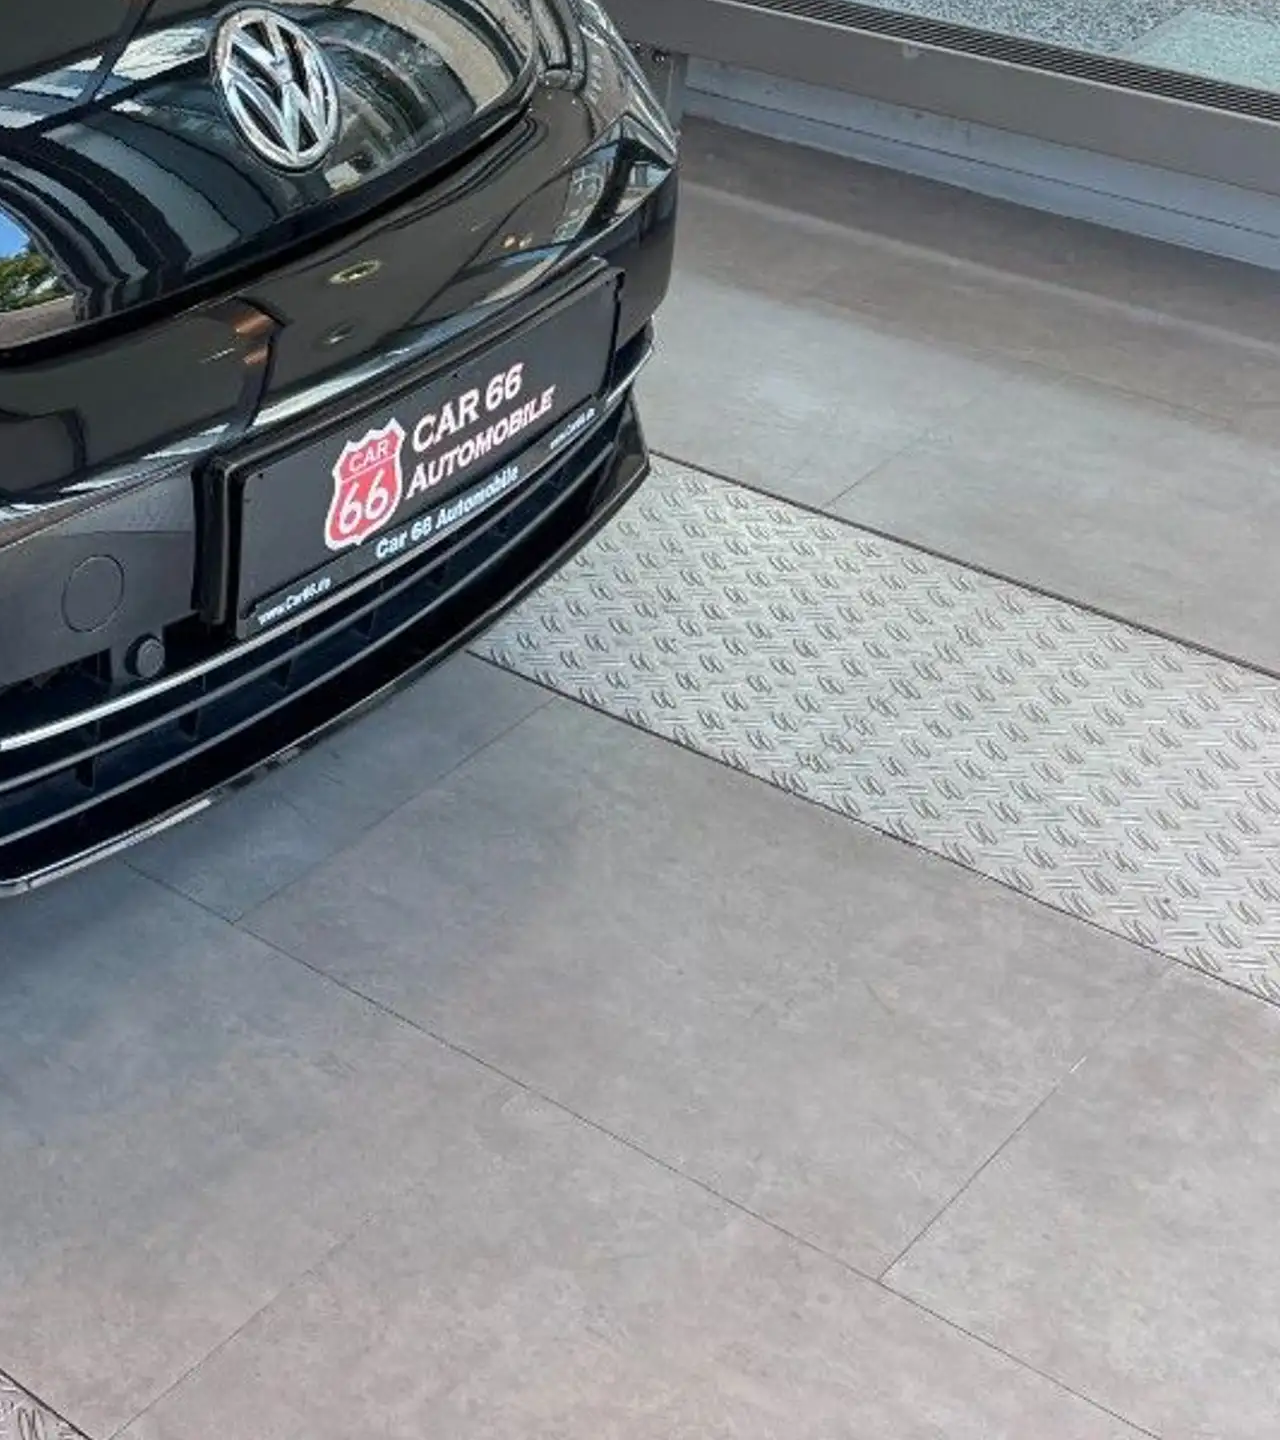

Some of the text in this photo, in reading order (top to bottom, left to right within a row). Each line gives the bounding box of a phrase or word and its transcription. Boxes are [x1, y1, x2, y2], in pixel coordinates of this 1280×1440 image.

[405, 385, 557, 500] AUTOMOBILE
[412, 363, 524, 452] CAR 66
[348, 439, 389, 472] CAR
[340, 467, 390, 535] 66
[375, 529, 408, 559] Car
[435, 465, 520, 530] Automobile
